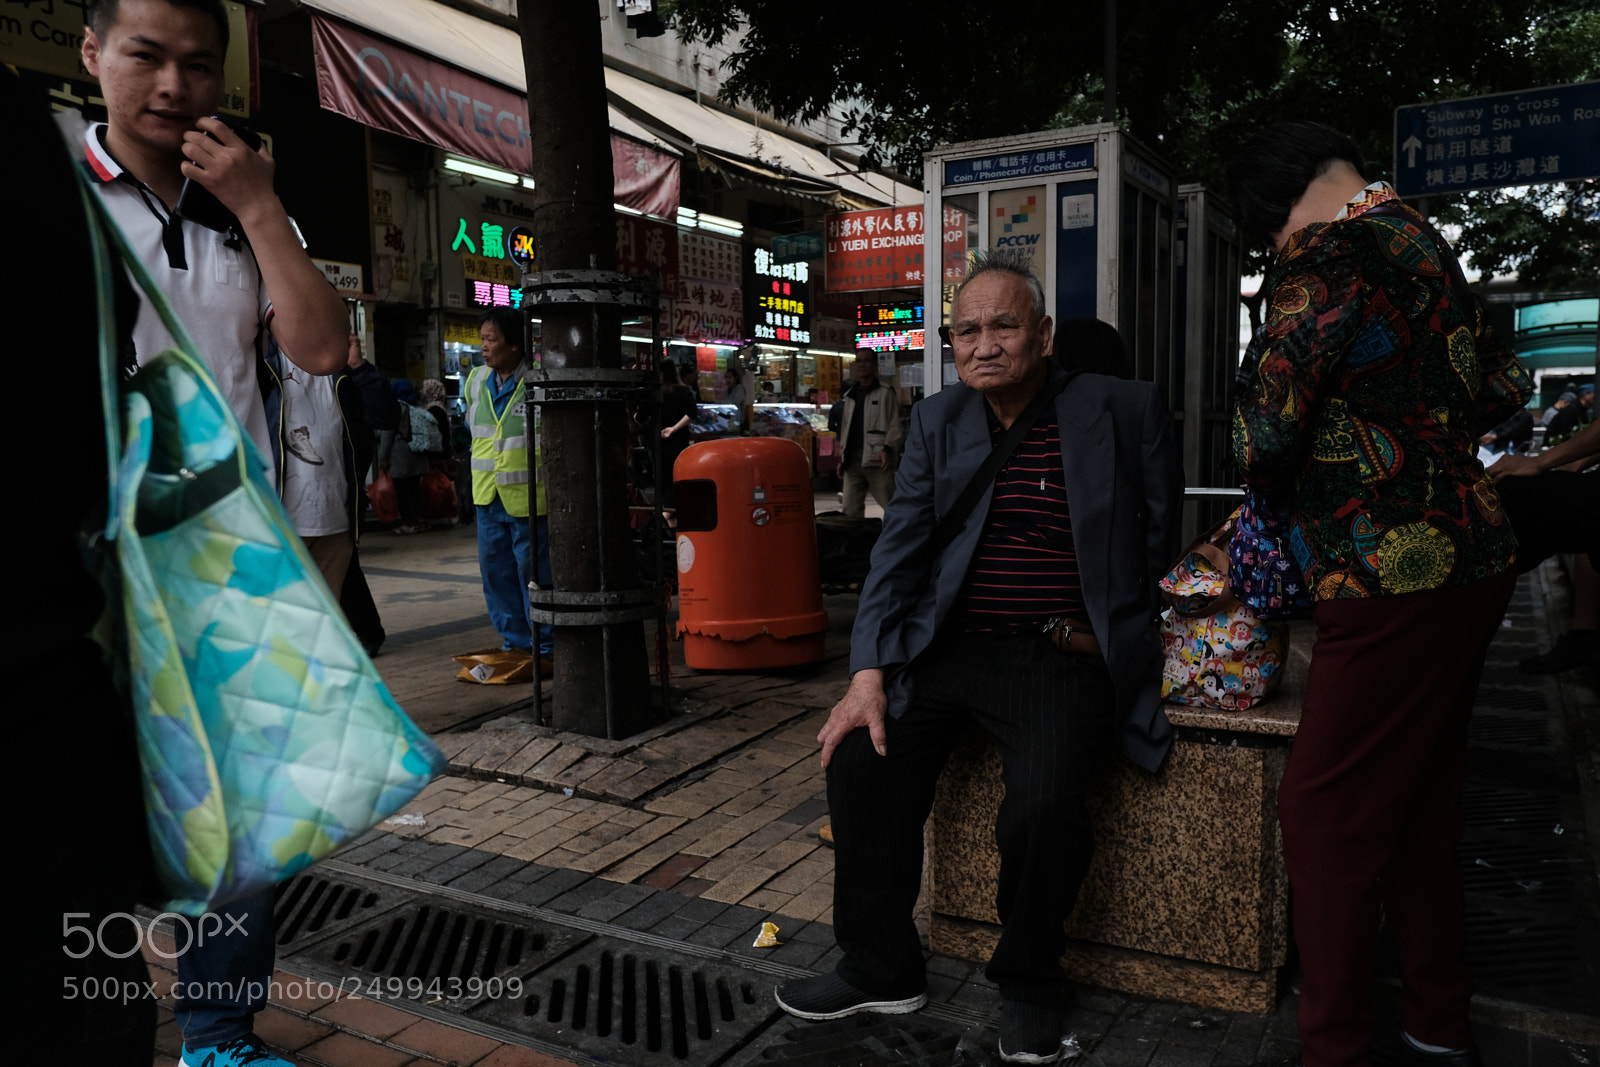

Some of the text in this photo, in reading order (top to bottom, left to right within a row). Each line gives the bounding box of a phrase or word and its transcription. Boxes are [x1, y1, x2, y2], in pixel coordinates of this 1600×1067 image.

[1426, 97, 1560, 123] Subway to cross
[1426, 108, 1600, 138] Cheung Sha Wan Roa
[1425, 135, 1513, 161] 請用隧道
[1065, 159, 1087, 169] Card
[481, 195, 501, 212] JK
[452, 218, 505, 259] 人氣
[828, 242, 837, 253] LI
[841, 239, 869, 252] YUEN
[997, 234, 1040, 247] PCCW
